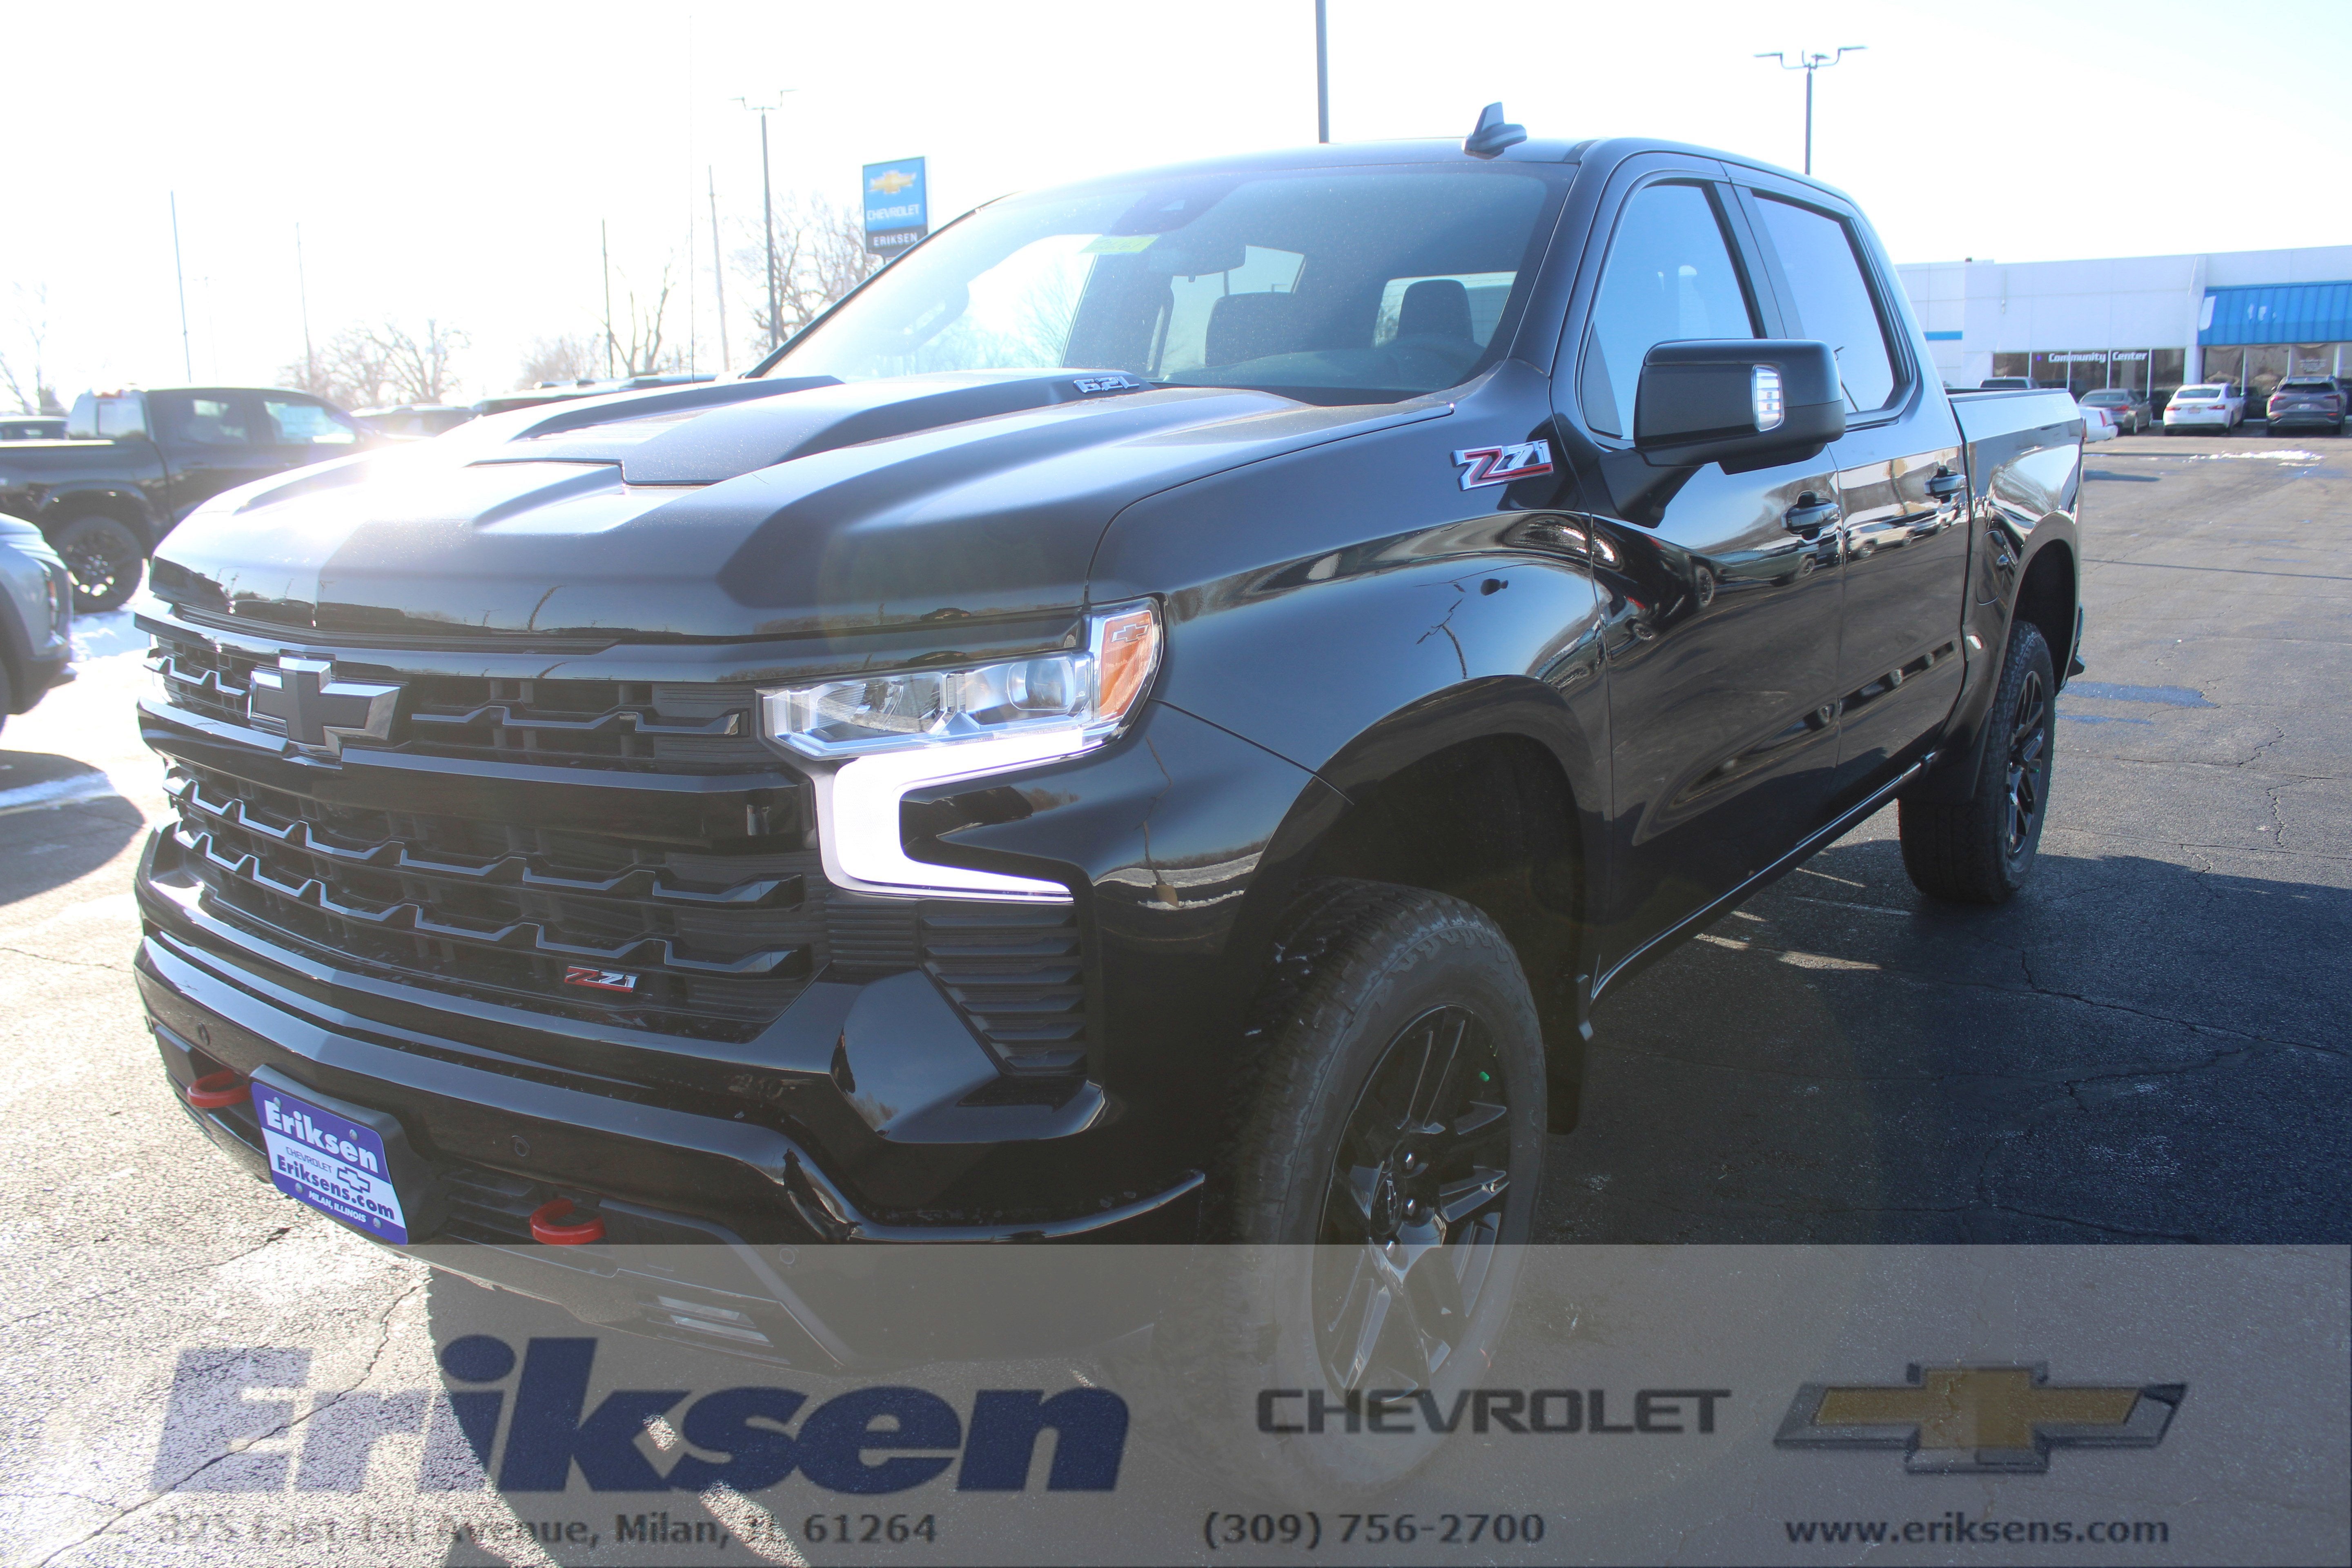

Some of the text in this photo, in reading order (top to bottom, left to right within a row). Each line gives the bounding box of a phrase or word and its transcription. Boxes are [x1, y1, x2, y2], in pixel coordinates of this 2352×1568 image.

[867, 204, 920, 220] CHEVROLET
[873, 232, 918, 247] ERIKSEN
[2048, 351, 2147, 363] Community Center
[1450, 439, 1554, 491] Z71
[564, 965, 638, 993] Z71
[264, 1099, 379, 1174] Eriksen
[286, 1146, 333, 1173] CHEVROLET
[277, 1154, 395, 1221] Eriksens.com
[334, 1203, 367, 1223] ILLINOIS
